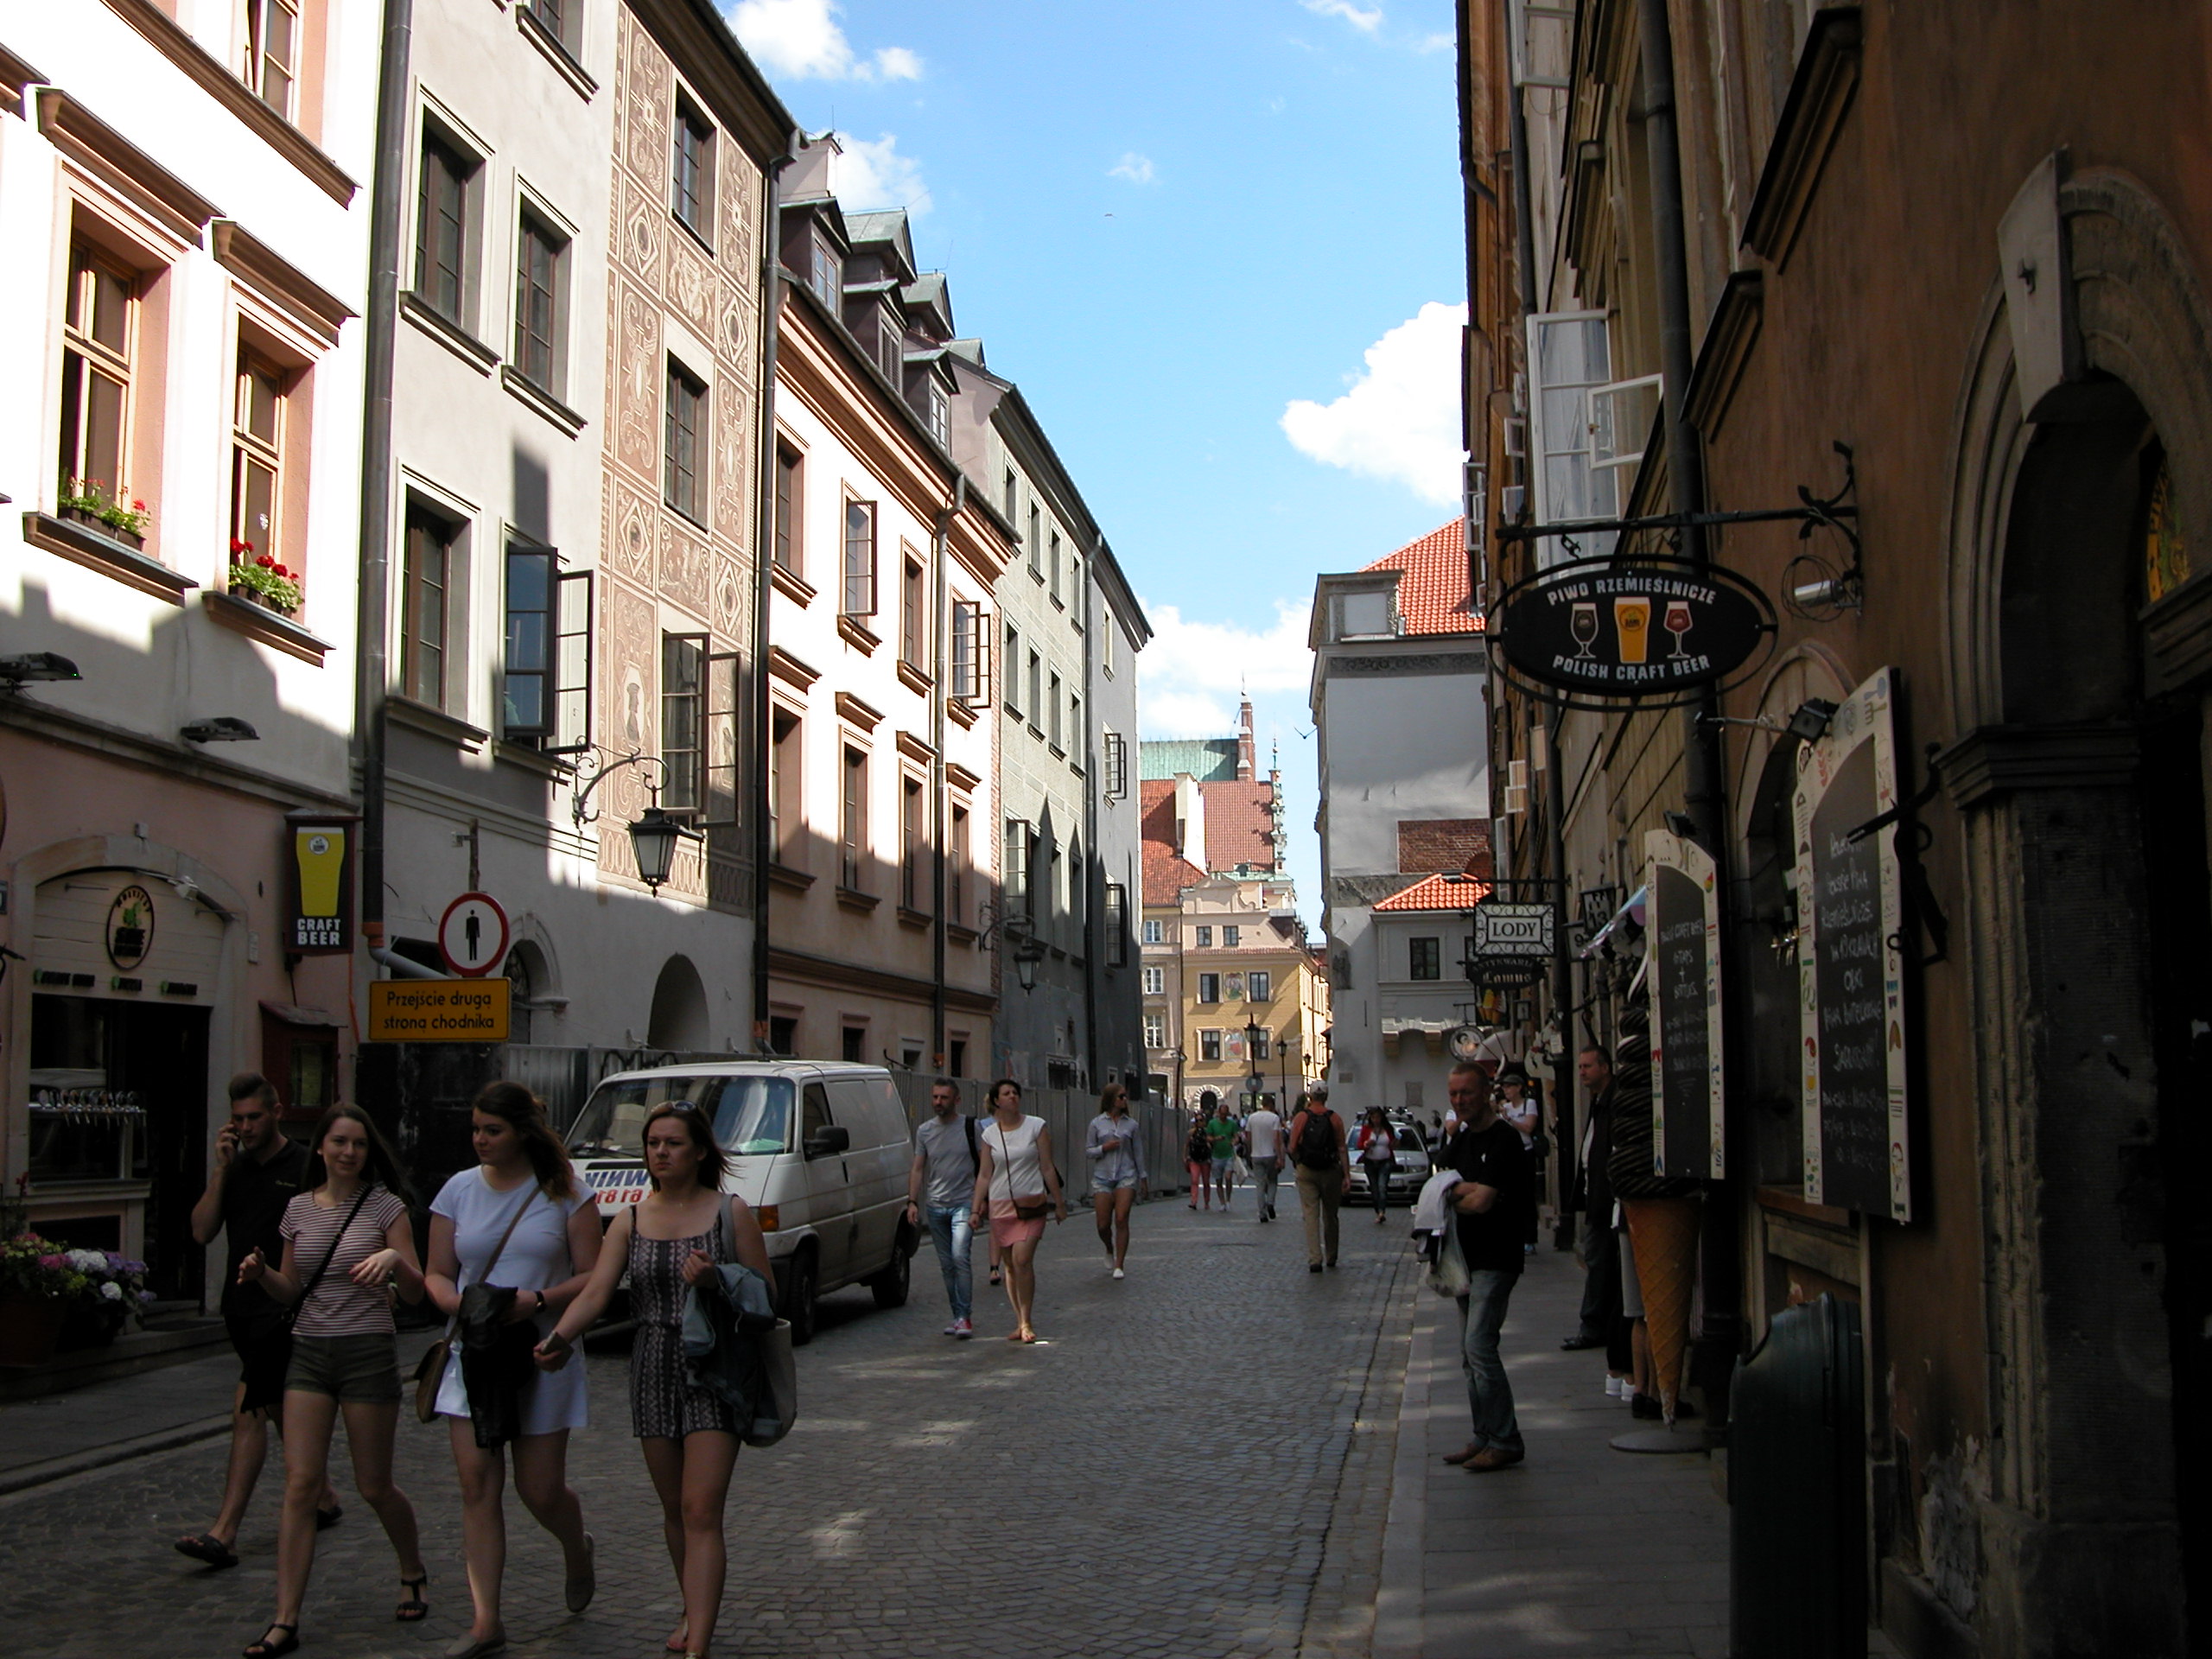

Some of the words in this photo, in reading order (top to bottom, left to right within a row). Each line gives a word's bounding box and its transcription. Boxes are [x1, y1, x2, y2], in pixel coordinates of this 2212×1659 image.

[1547, 582, 1590, 606] PIWO
[1596, 576, 1717, 605] RZEMIEŚLNICZE
[1552, 654, 1608, 679] POLISH
[1616, 664, 1665, 681] CRAFT
[1673, 655, 1711, 677] BEER
[297, 918, 341, 931] CRAFT
[1493, 922, 1536, 937] LODY
[297, 931, 340, 945] BEER
[386, 990, 445, 1008] Przejście
[449, 990, 493, 1010] drugą
[384, 1014, 427, 1033] stroną
[431, 1013, 494, 1029] chodnika
